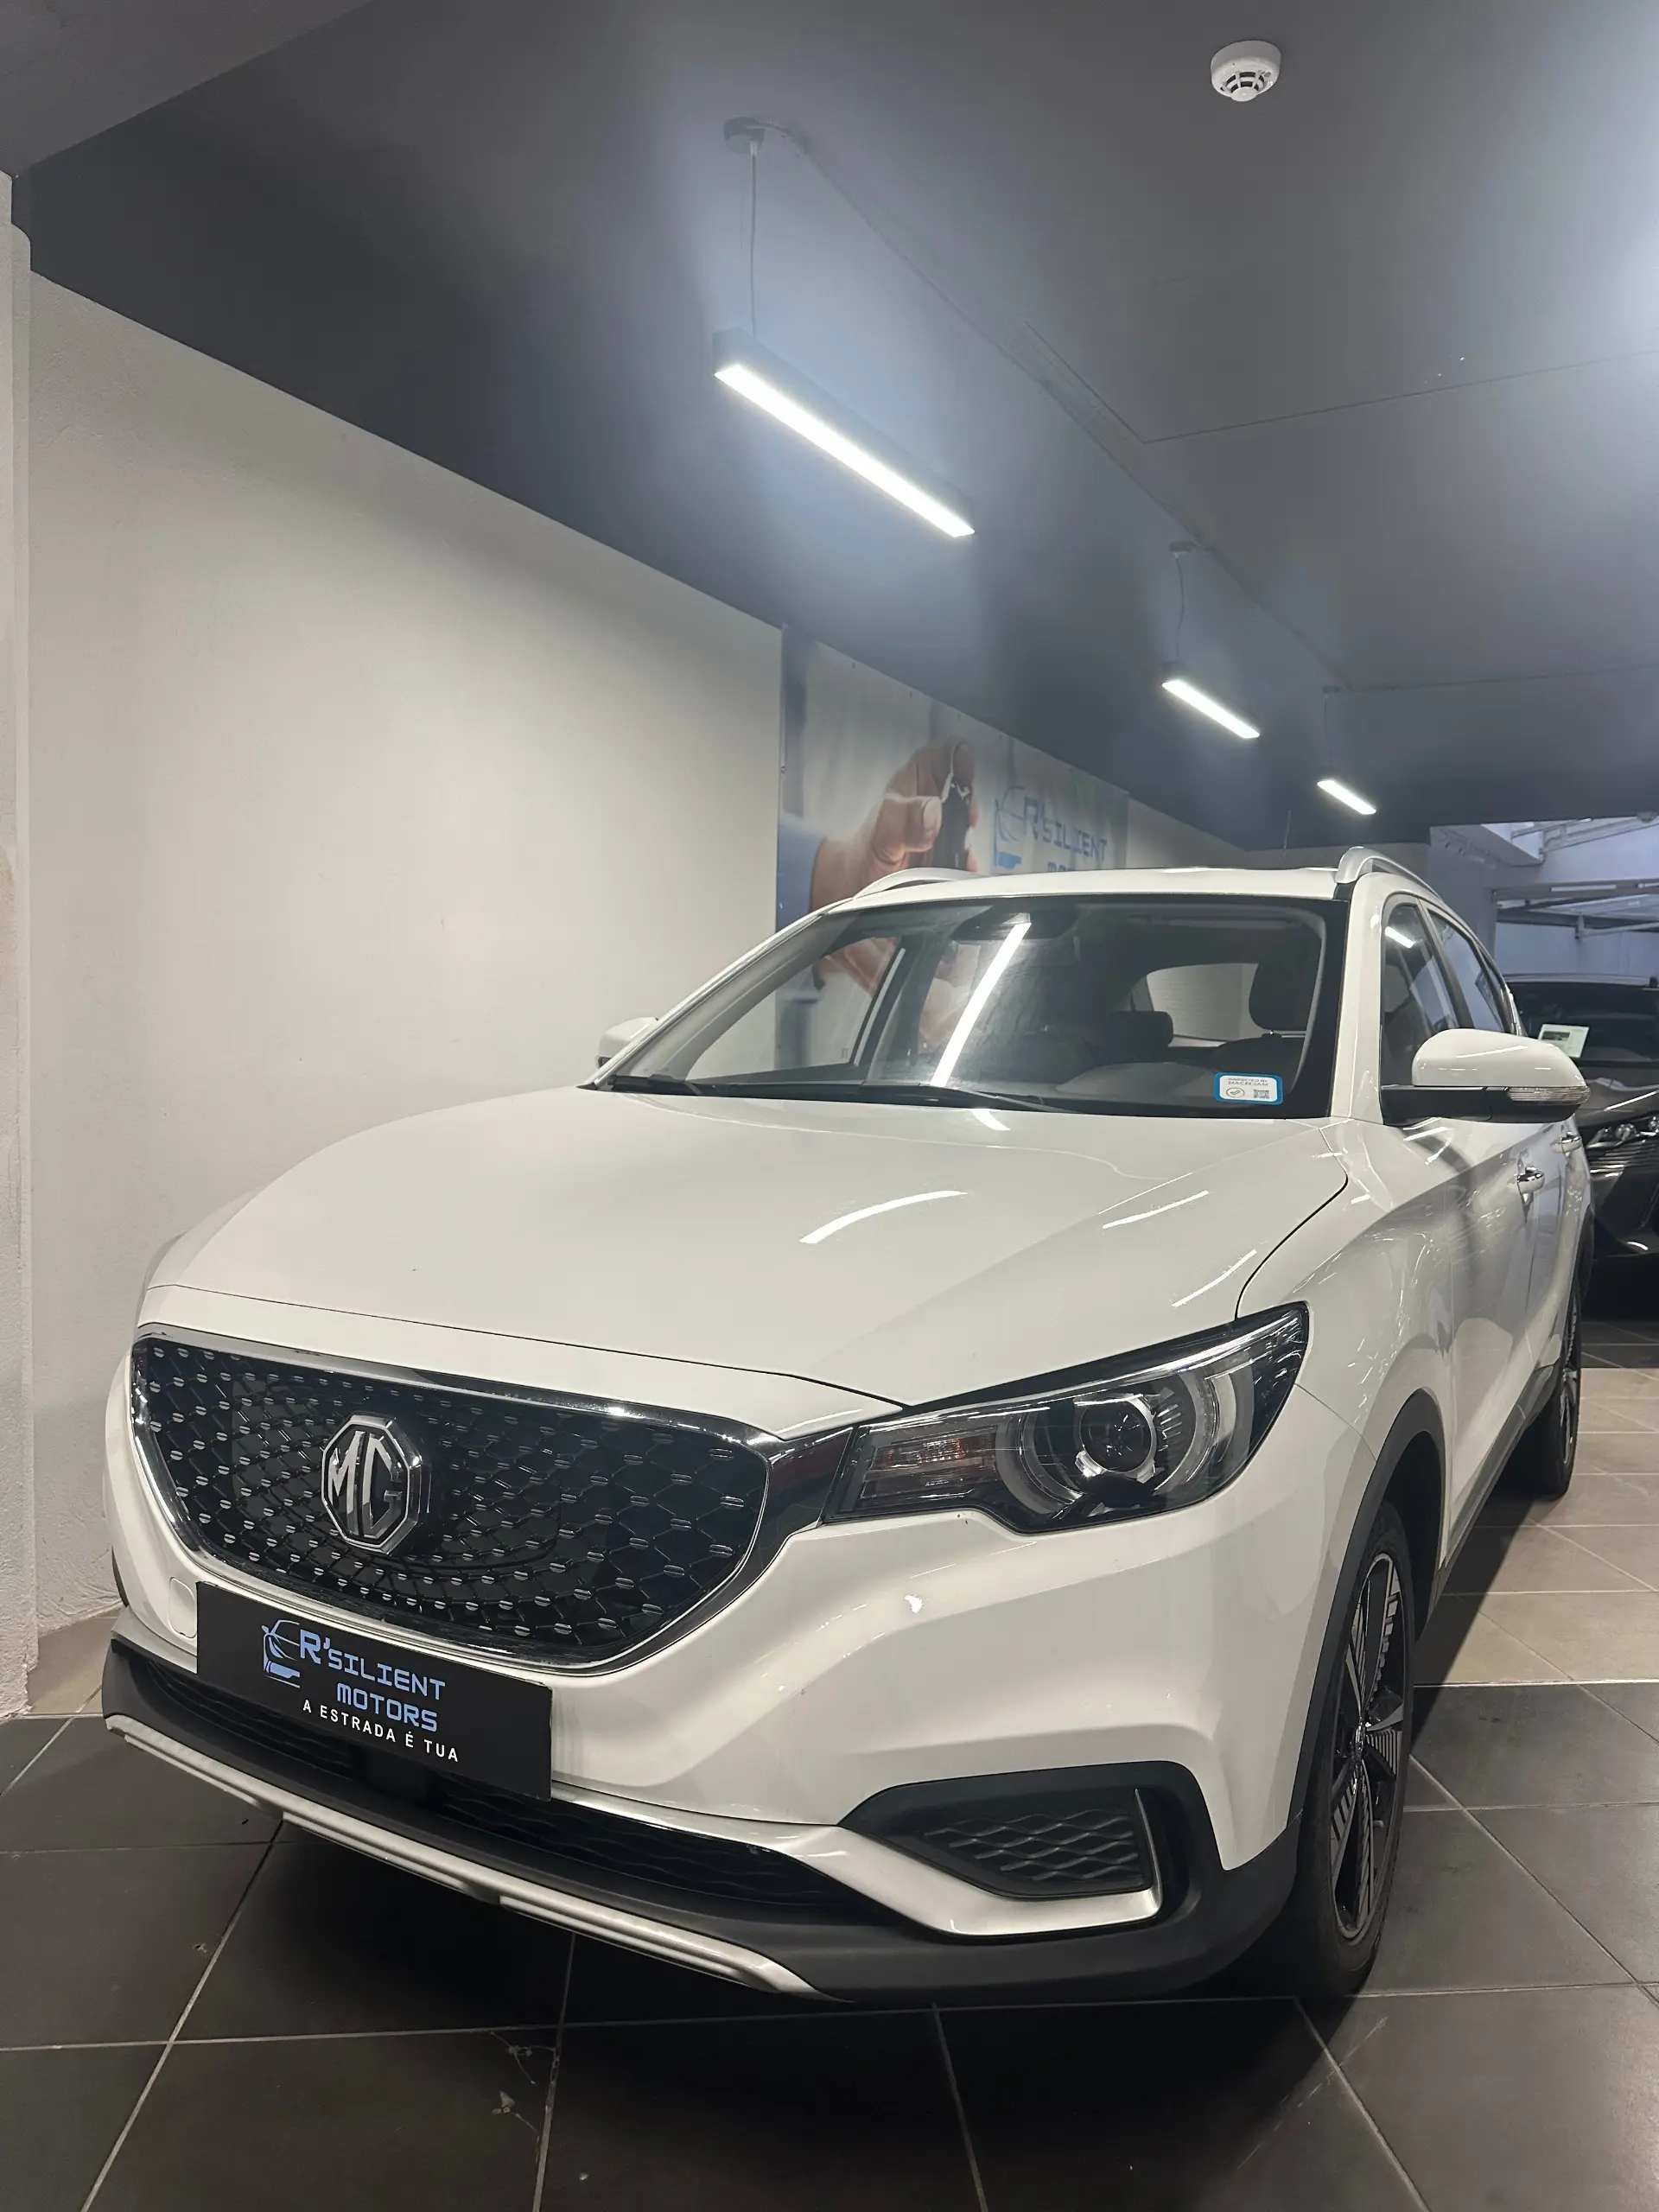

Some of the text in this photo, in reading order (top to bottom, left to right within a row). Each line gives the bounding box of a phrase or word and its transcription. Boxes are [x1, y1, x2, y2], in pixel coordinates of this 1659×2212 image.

[327, 1430, 404, 1539] MG
[299, 1629, 446, 1700] R'SILIENT
[302, 1699, 459, 1763] A ESTRADA É TUA
[336, 1682, 437, 1732] MOTORS
